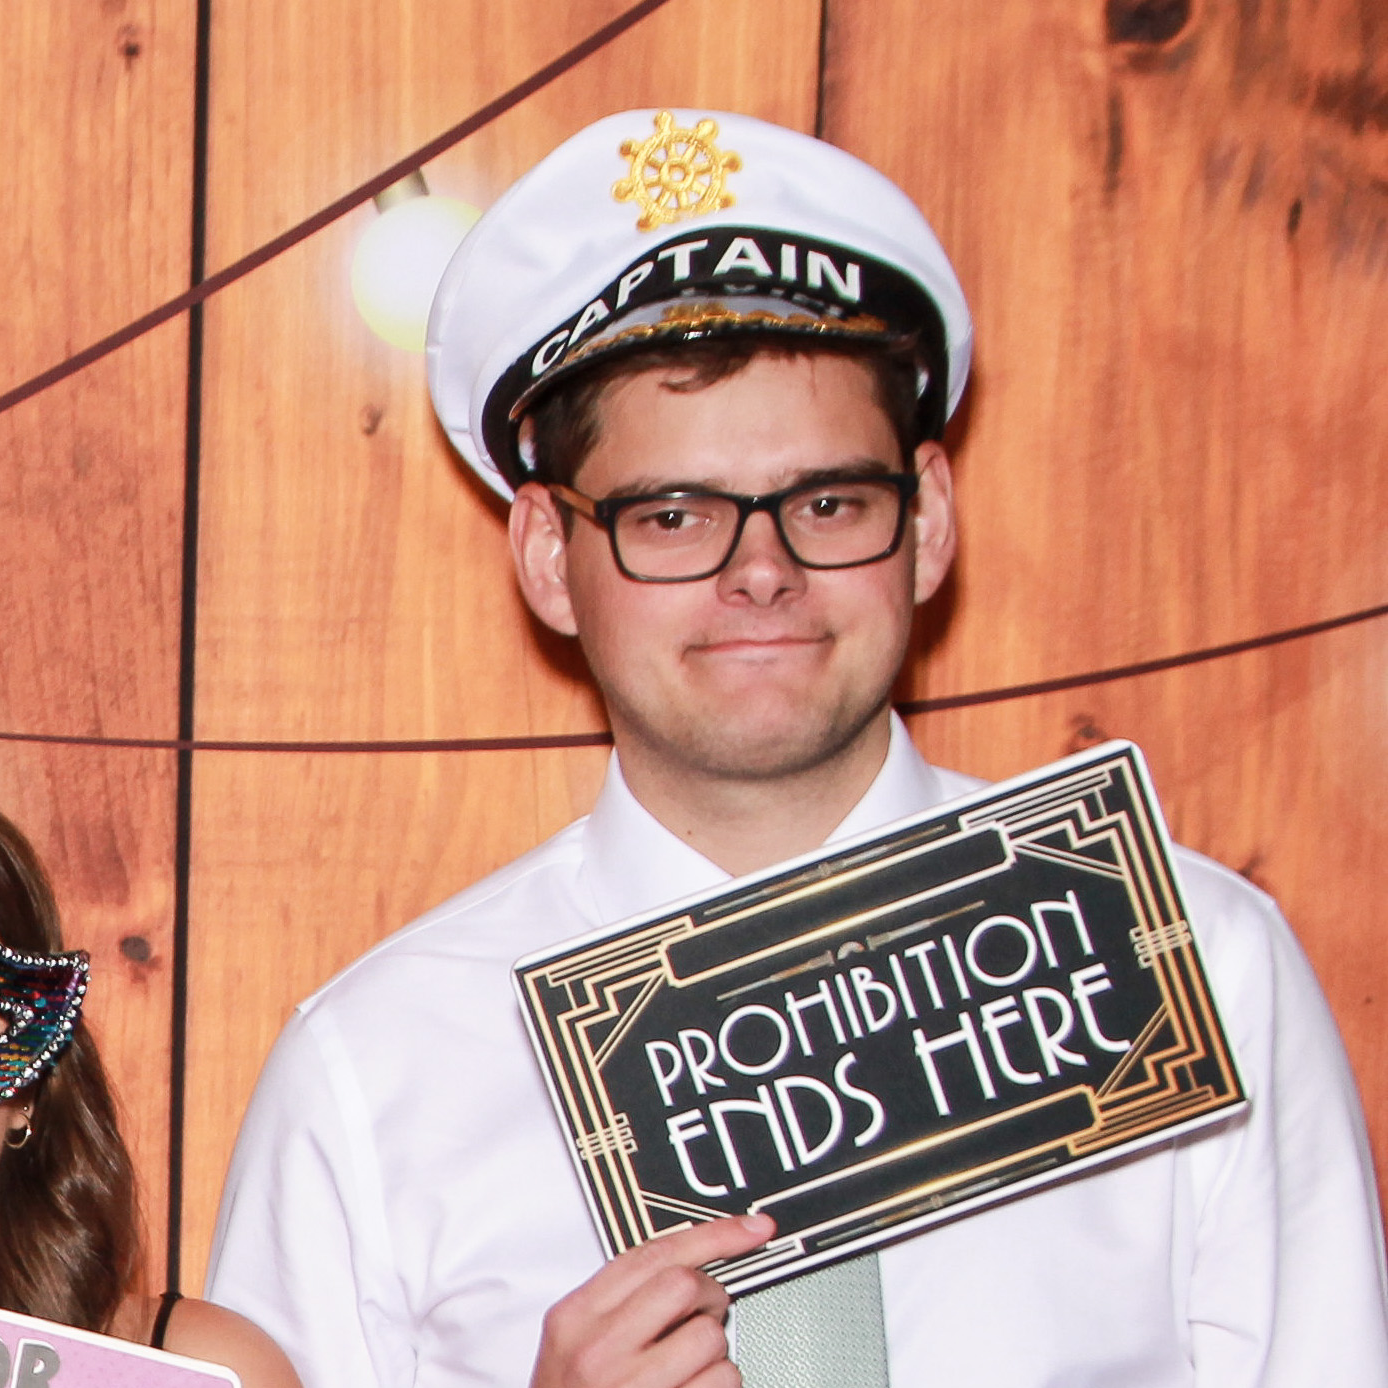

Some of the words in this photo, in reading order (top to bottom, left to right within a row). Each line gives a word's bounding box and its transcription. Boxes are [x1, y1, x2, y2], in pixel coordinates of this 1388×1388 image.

[531, 236, 861, 378] CAPTAIN
[645, 890, 1094, 1106] PROHIBITION
[665, 1052, 885, 1197] ENDS
[913, 962, 1131, 1114] HERE
